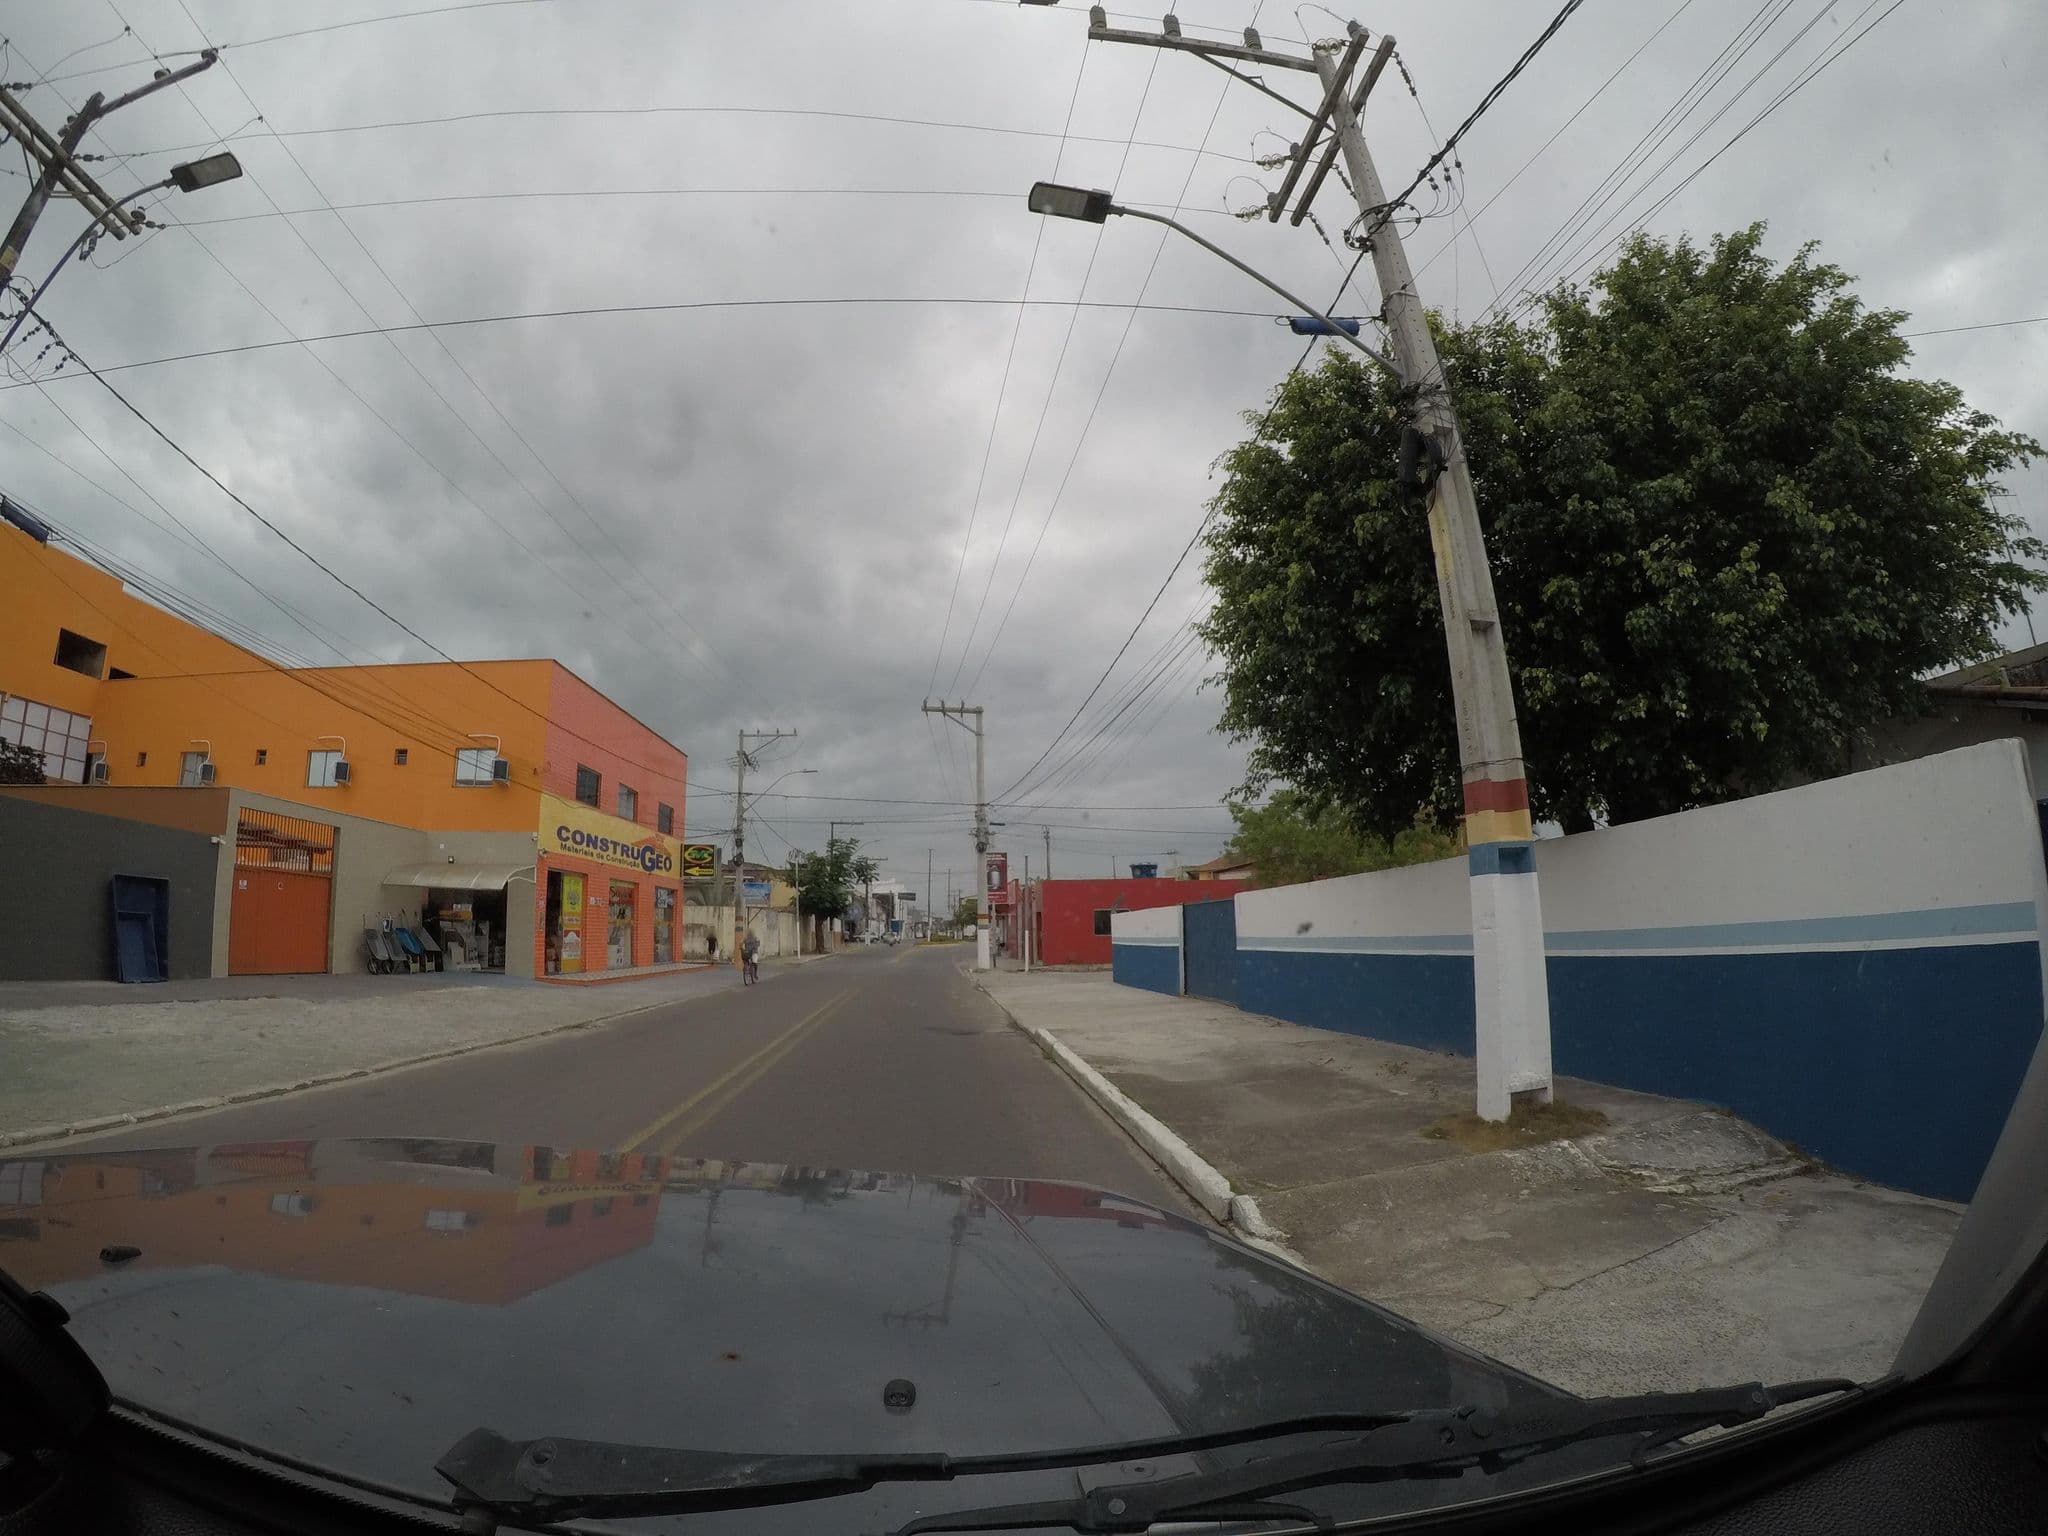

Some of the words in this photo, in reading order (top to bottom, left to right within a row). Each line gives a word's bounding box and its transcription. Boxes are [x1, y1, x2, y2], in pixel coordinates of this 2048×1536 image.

[557, 825, 672, 872] CONSTRUGEO
[560, 842, 594, 857] Materiais
[606, 855, 640, 868] Construção
